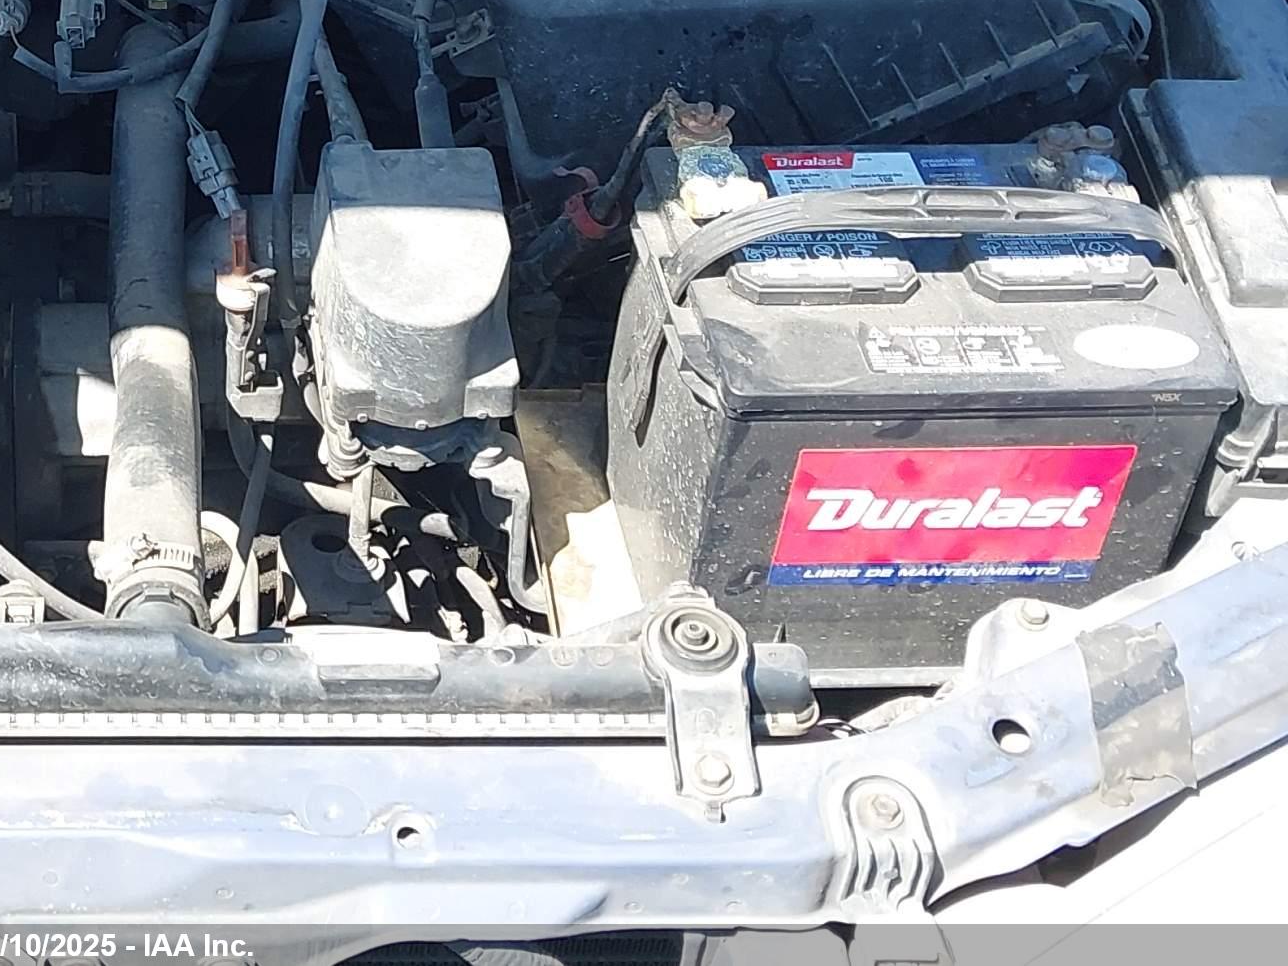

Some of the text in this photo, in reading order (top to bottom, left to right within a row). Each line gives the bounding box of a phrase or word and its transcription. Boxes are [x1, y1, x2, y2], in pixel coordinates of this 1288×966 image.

[772, 157, 844, 167] Duralast
[761, 233, 813, 242] ANGER
[827, 232, 878, 241] POISON
[805, 486, 1104, 531] Duralast
[803, 568, 861, 579] LIBRE
[864, 568, 894, 578] DE
[897, 566, 1062, 578] MANTENIMIENTO
